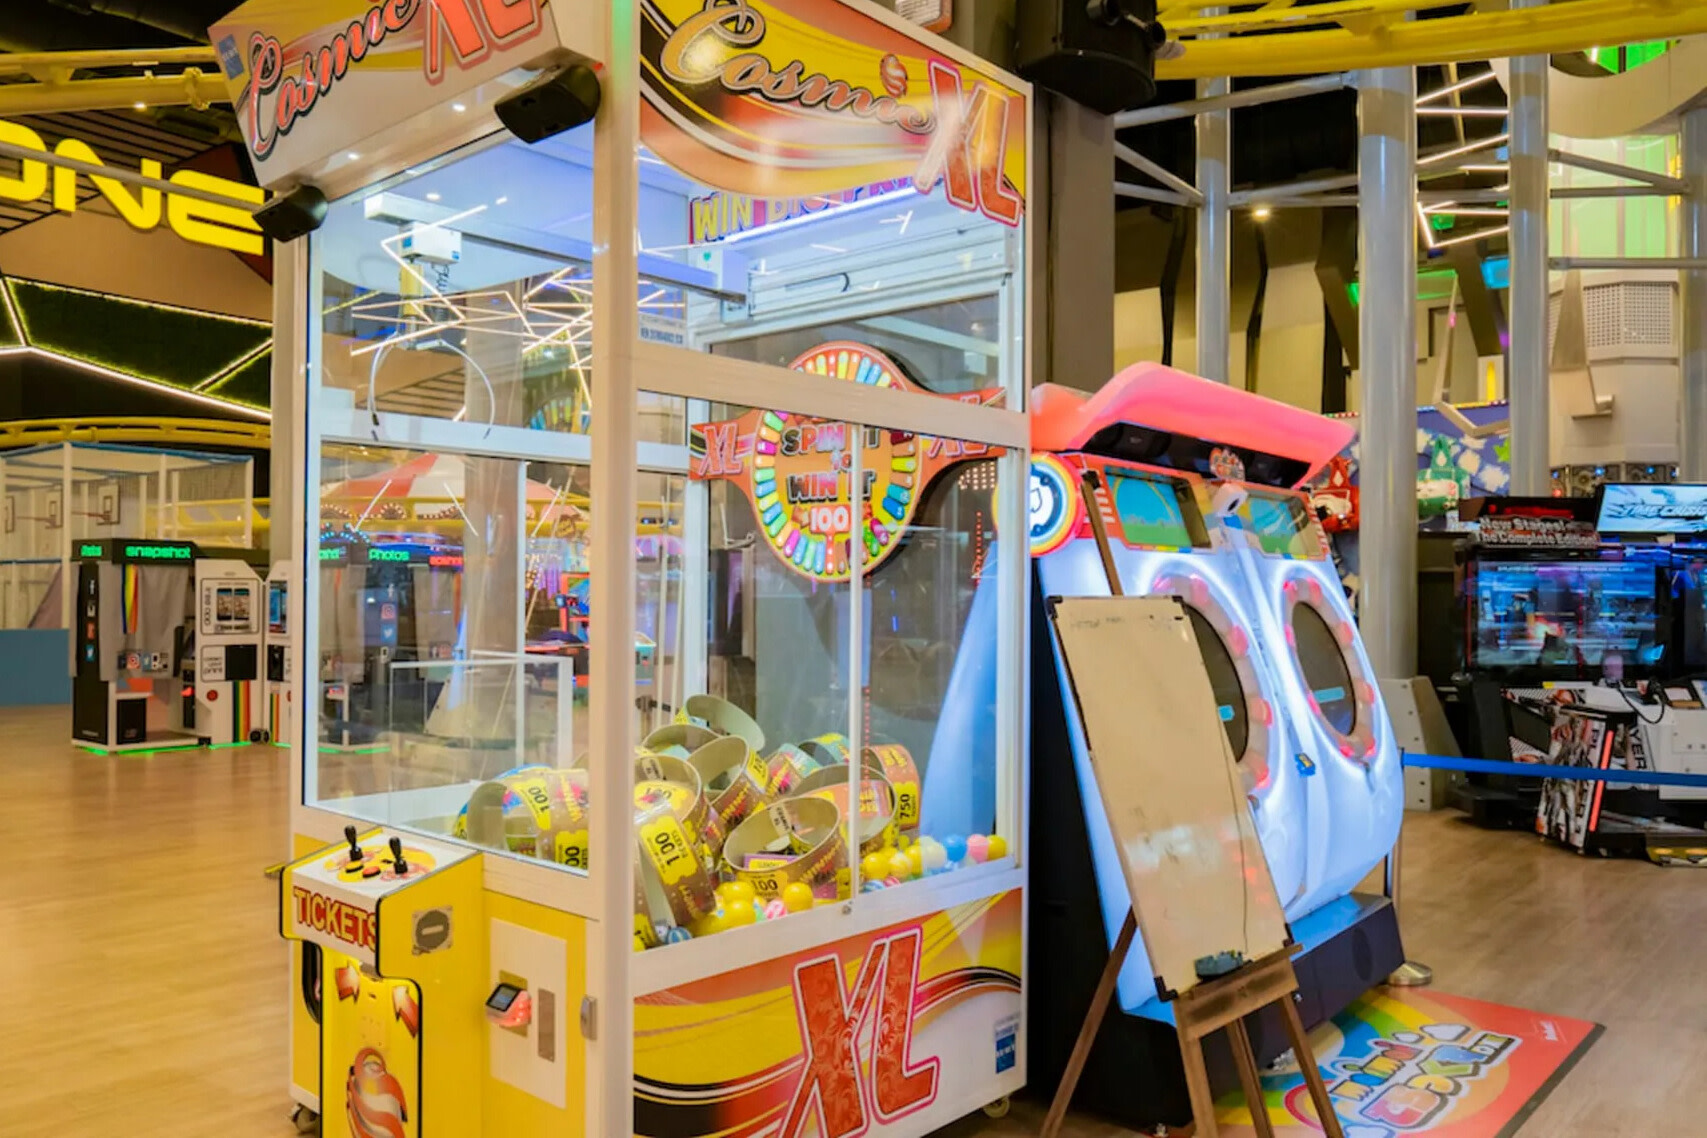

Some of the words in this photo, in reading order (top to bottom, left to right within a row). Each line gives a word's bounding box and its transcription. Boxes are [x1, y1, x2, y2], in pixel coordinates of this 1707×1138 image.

[660, 0, 937, 134] Cosmic
[913, 58, 1022, 228] XL
[692, 195, 754, 243] WIN
[697, 422, 744, 476] XL
[781, 421, 847, 455] SPIN
[787, 470, 839, 503] WIN
[811, 506, 850, 533] 100
[900, 793, 911, 820] 750
[654, 832, 680, 866] 100
[752, 878, 779, 892] 100
[293, 886, 377, 953] TICKETS
[775, 924, 941, 1138] XL
